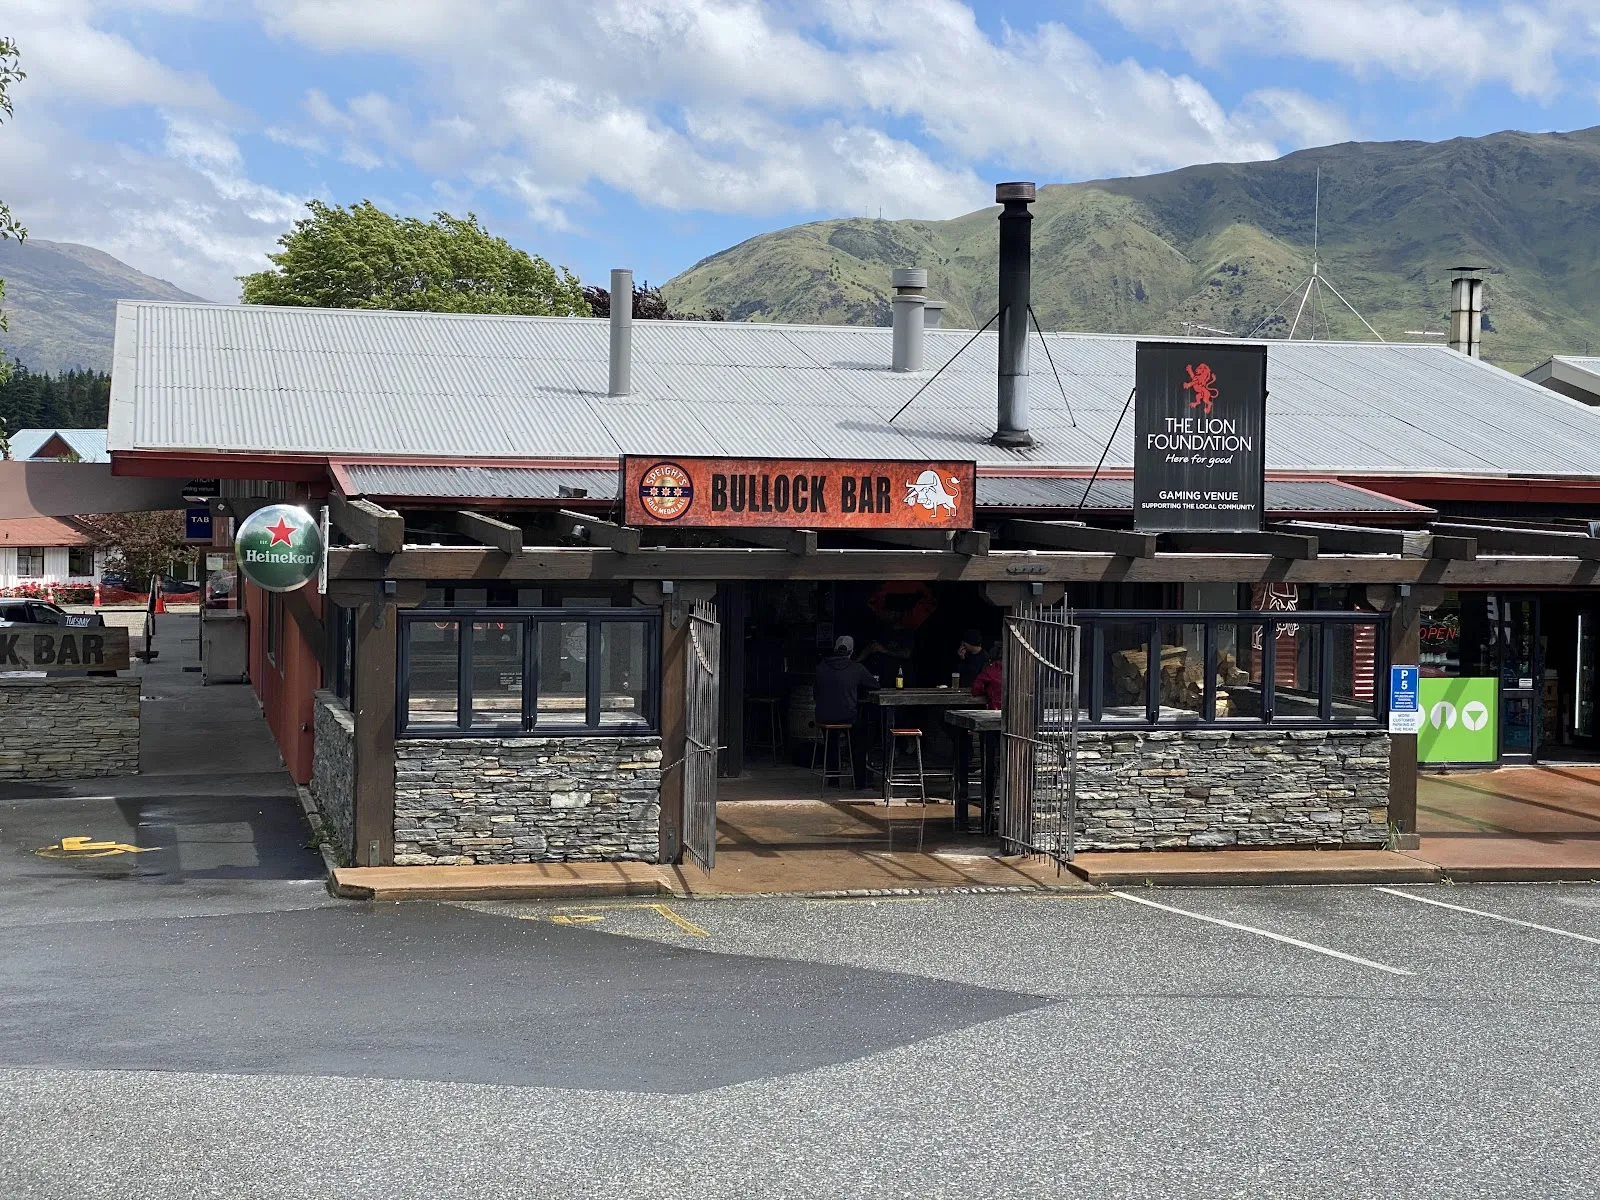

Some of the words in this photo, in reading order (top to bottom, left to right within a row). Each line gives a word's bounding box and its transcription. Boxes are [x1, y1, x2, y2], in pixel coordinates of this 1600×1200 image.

[1165, 417, 1193, 433] THE
[1197, 418, 1235, 434] LION
[1147, 434, 1252, 451] FOUNDATION
[1165, 454, 1189, 463] Here
[1191, 454, 1207, 464] for
[1206, 455, 1233, 468] good
[646, 467, 687, 486] SPEIGHT'S
[712, 474, 827, 513] BULLOCK
[841, 476, 891, 514] BAR
[1159, 490, 1201, 500] GAMING
[1204, 491, 1239, 501] VENUE
[658, 507, 678, 515] MEDAL
[1142, 502, 1182, 510] SUPPORTING
[246, 550, 314, 564] Heineken
[1420, 627, 1457, 640] OPEN
[34, 634, 104, 665] BAR
[1401, 670, 1408, 679] P
[1401, 680, 1408, 690] 5
